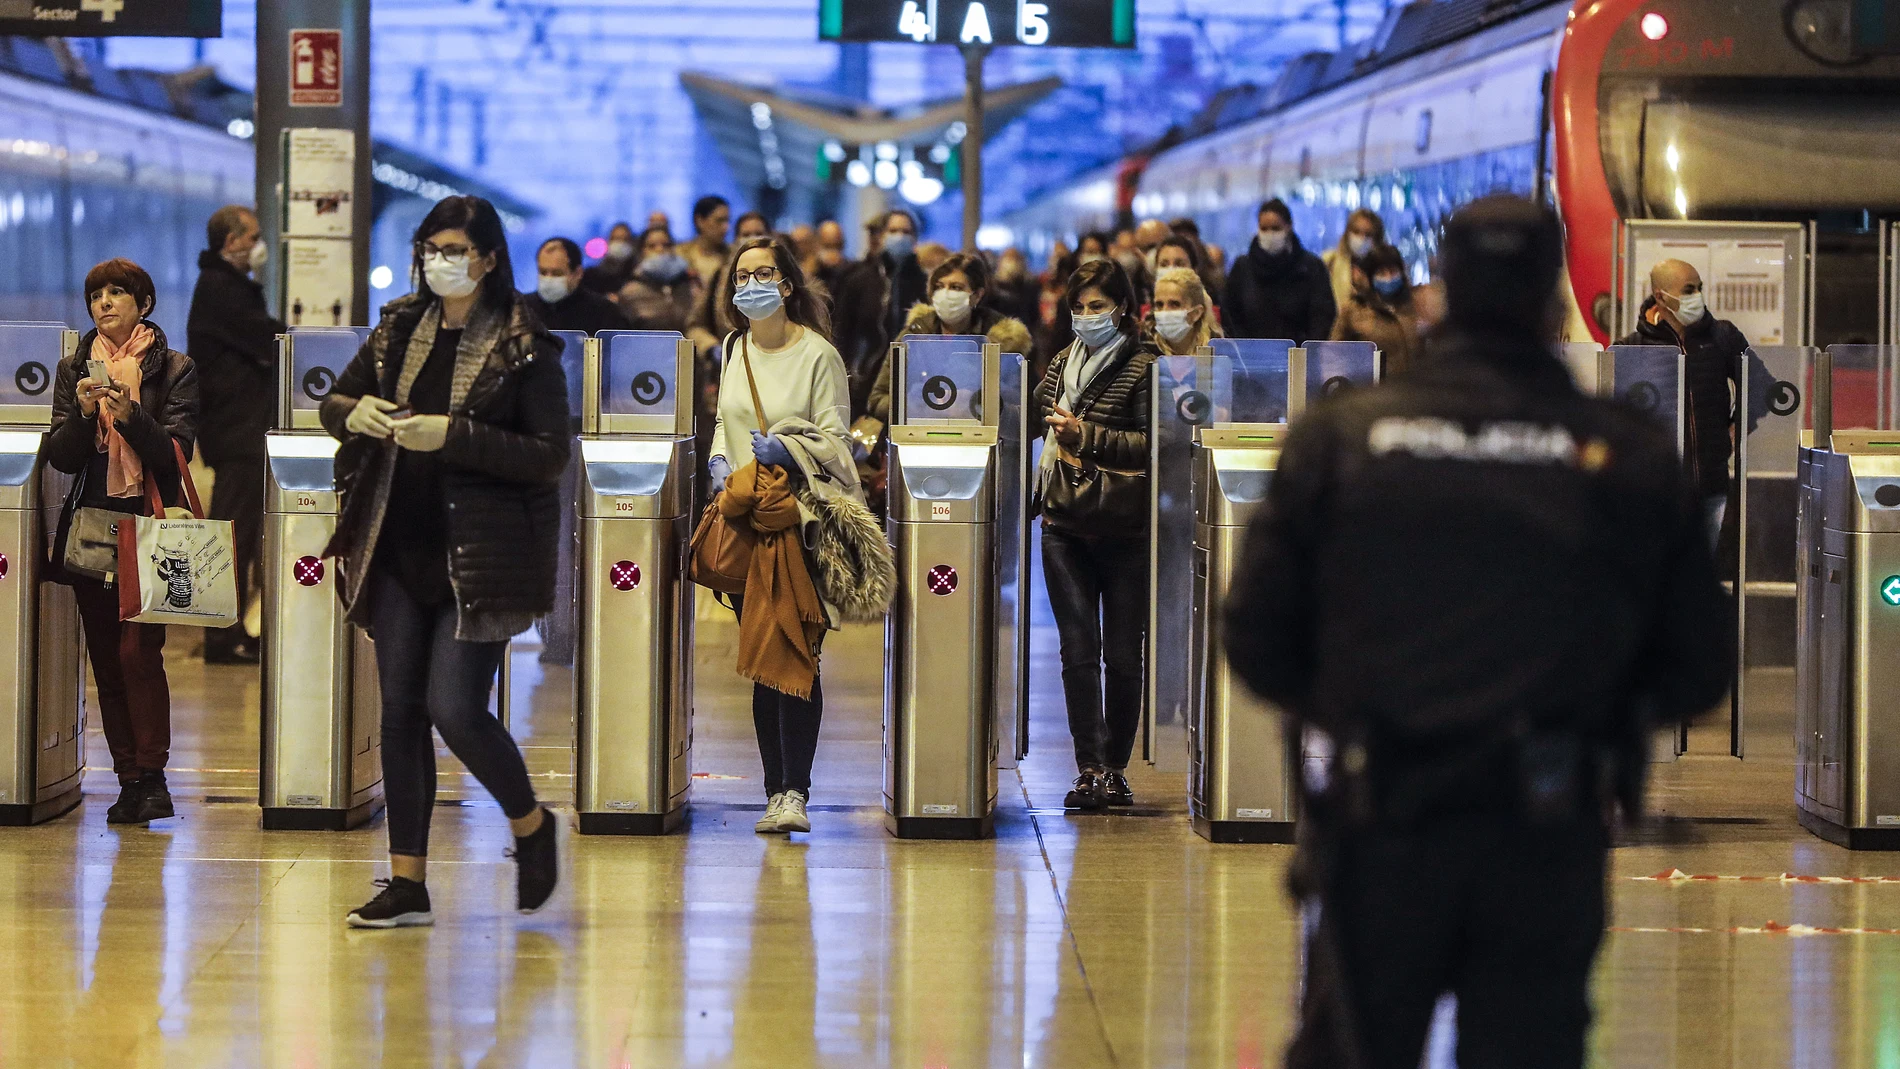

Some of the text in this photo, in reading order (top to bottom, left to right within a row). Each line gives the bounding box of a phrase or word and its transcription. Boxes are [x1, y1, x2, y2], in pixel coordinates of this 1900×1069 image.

[33, 6, 79, 20] Sector
[899, 1, 1049, 45] 4 A 5
[1701, 37, 1734, 62] M
[298, 497, 316, 506] 104
[616, 502, 633, 511] 105
[932, 506, 950, 515] 106
